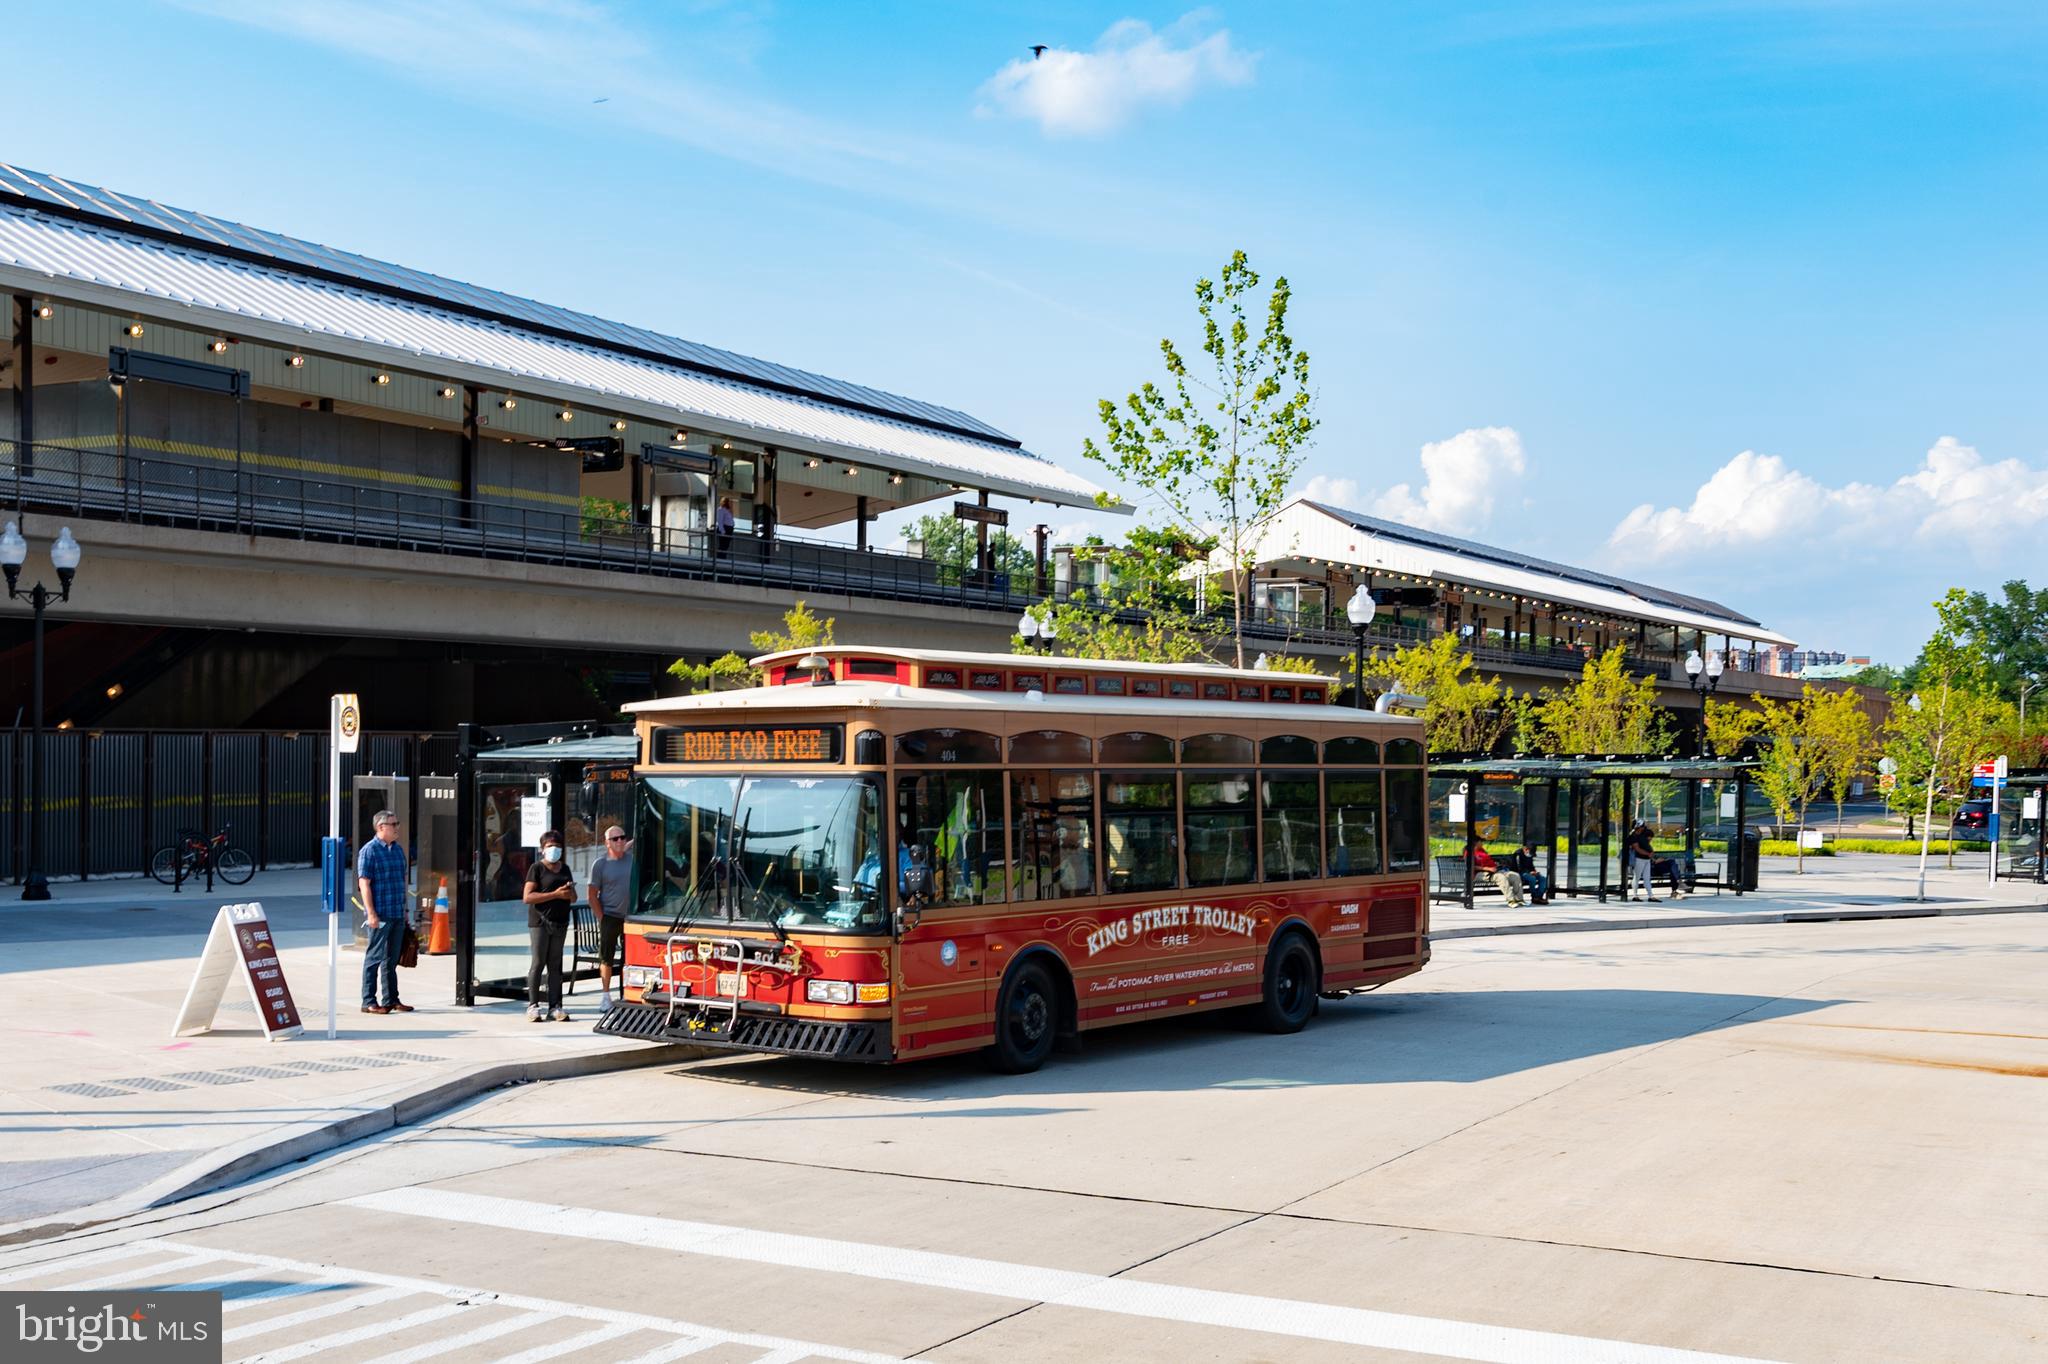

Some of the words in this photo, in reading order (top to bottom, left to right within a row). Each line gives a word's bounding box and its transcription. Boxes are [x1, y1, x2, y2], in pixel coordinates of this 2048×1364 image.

[683, 731, 726, 761] RIDE
[730, 731, 769, 760] FOR
[773, 729, 821, 760] FREE
[941, 750, 956, 761] 404
[538, 778, 552, 797] D
[1460, 783, 1469, 794] C
[1341, 903, 1359, 915] DASH
[253, 930, 270, 941] FREE
[1086, 918, 1128, 957] KING
[1132, 904, 1190, 936] STREET
[1193, 905, 1257, 938] TROLLEY
[1161, 934, 1190, 947] FREE
[248, 959, 263, 969] KING
[262, 957, 278, 967] STREET
[257, 969, 279, 980] TROLLEY
[1118, 976, 1152, 988] POTOMAC
[1153, 972, 1174, 983] RIVER
[1175, 967, 1218, 980] WATERFRONT
[1232, 962, 1255, 972] METRO
[265, 987, 283, 998] BOARD
[271, 1000, 286, 1010] HERE
